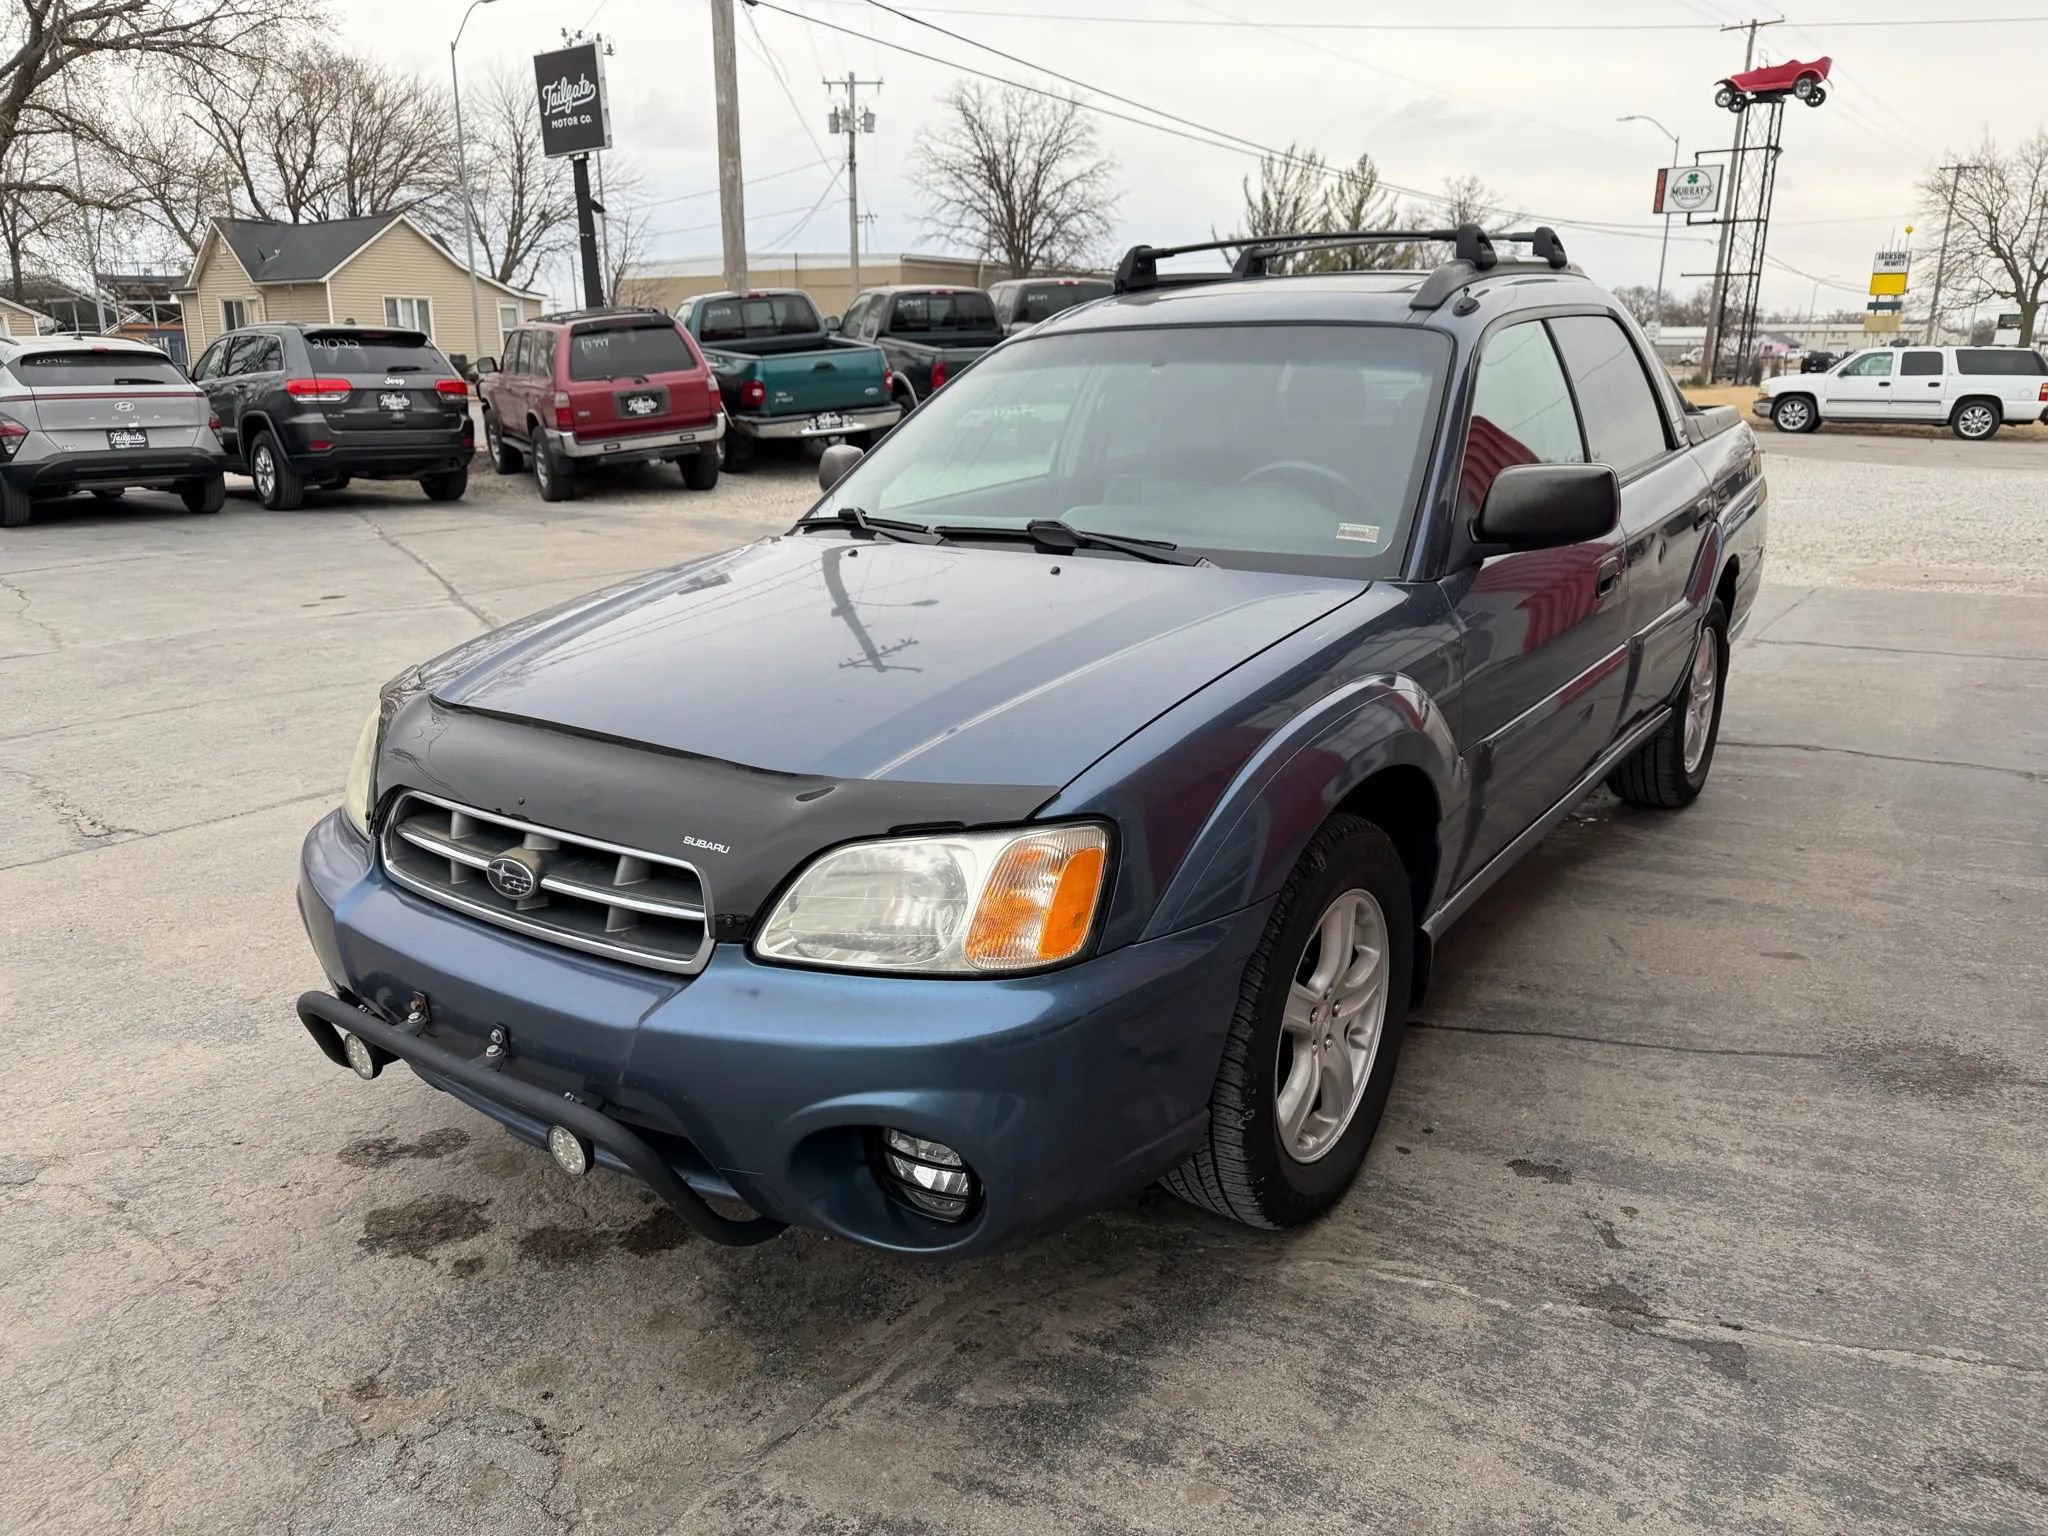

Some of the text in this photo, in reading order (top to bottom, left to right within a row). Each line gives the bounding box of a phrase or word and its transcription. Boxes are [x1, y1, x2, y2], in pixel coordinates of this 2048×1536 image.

[542, 73, 596, 116] Tailgate
[551, 114, 593, 129] MOTOR CO.
[1878, 252, 1906, 260] JACKSON
[384, 376, 405, 386] Jeep
[110, 431, 146, 445] Tailgate
[683, 835, 731, 854] SUBARU
